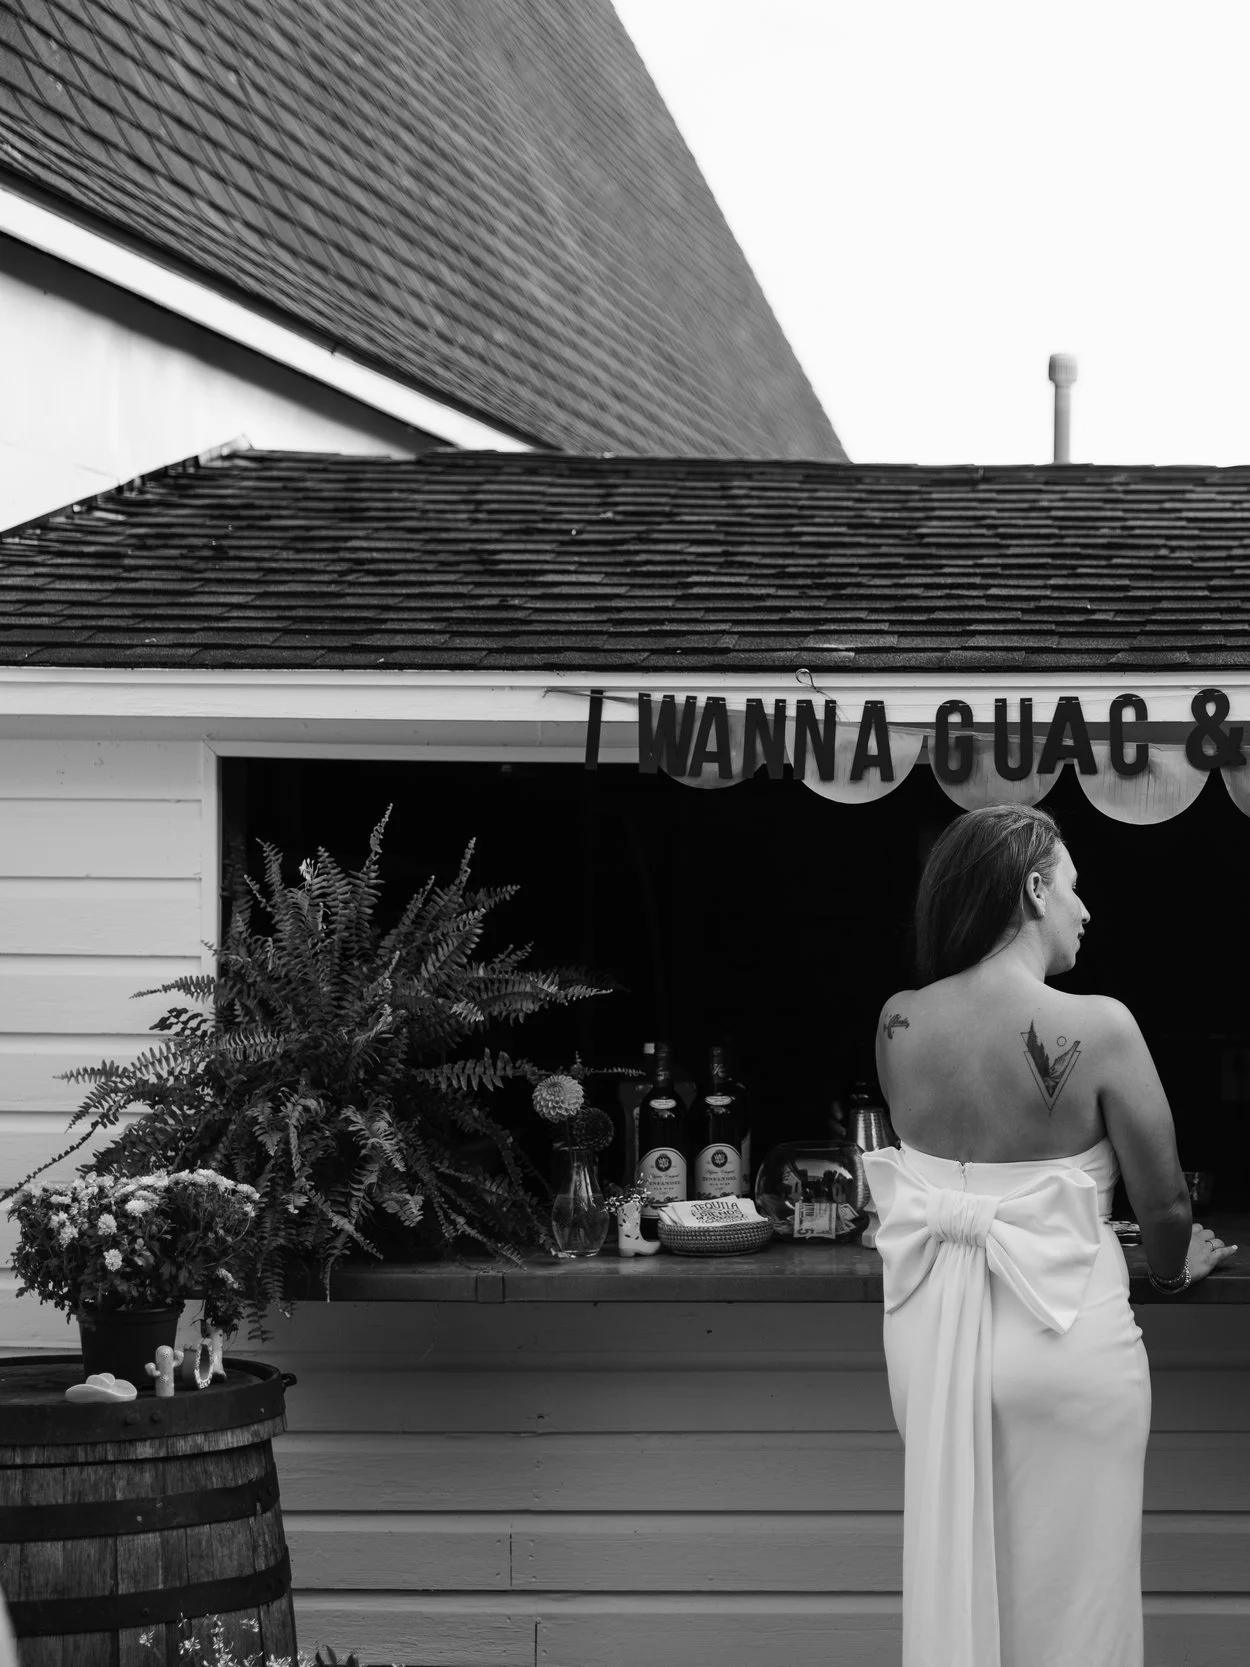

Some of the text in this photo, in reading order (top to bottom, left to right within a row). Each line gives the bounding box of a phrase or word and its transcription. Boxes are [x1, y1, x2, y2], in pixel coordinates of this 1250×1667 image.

[585, 689, 604, 770] I
[638, 693, 894, 781] WANNA
[935, 694, 1149, 782] GUAC
[1186, 688, 1247, 769] &
[691, 1201, 740, 1211] TEQUILA
